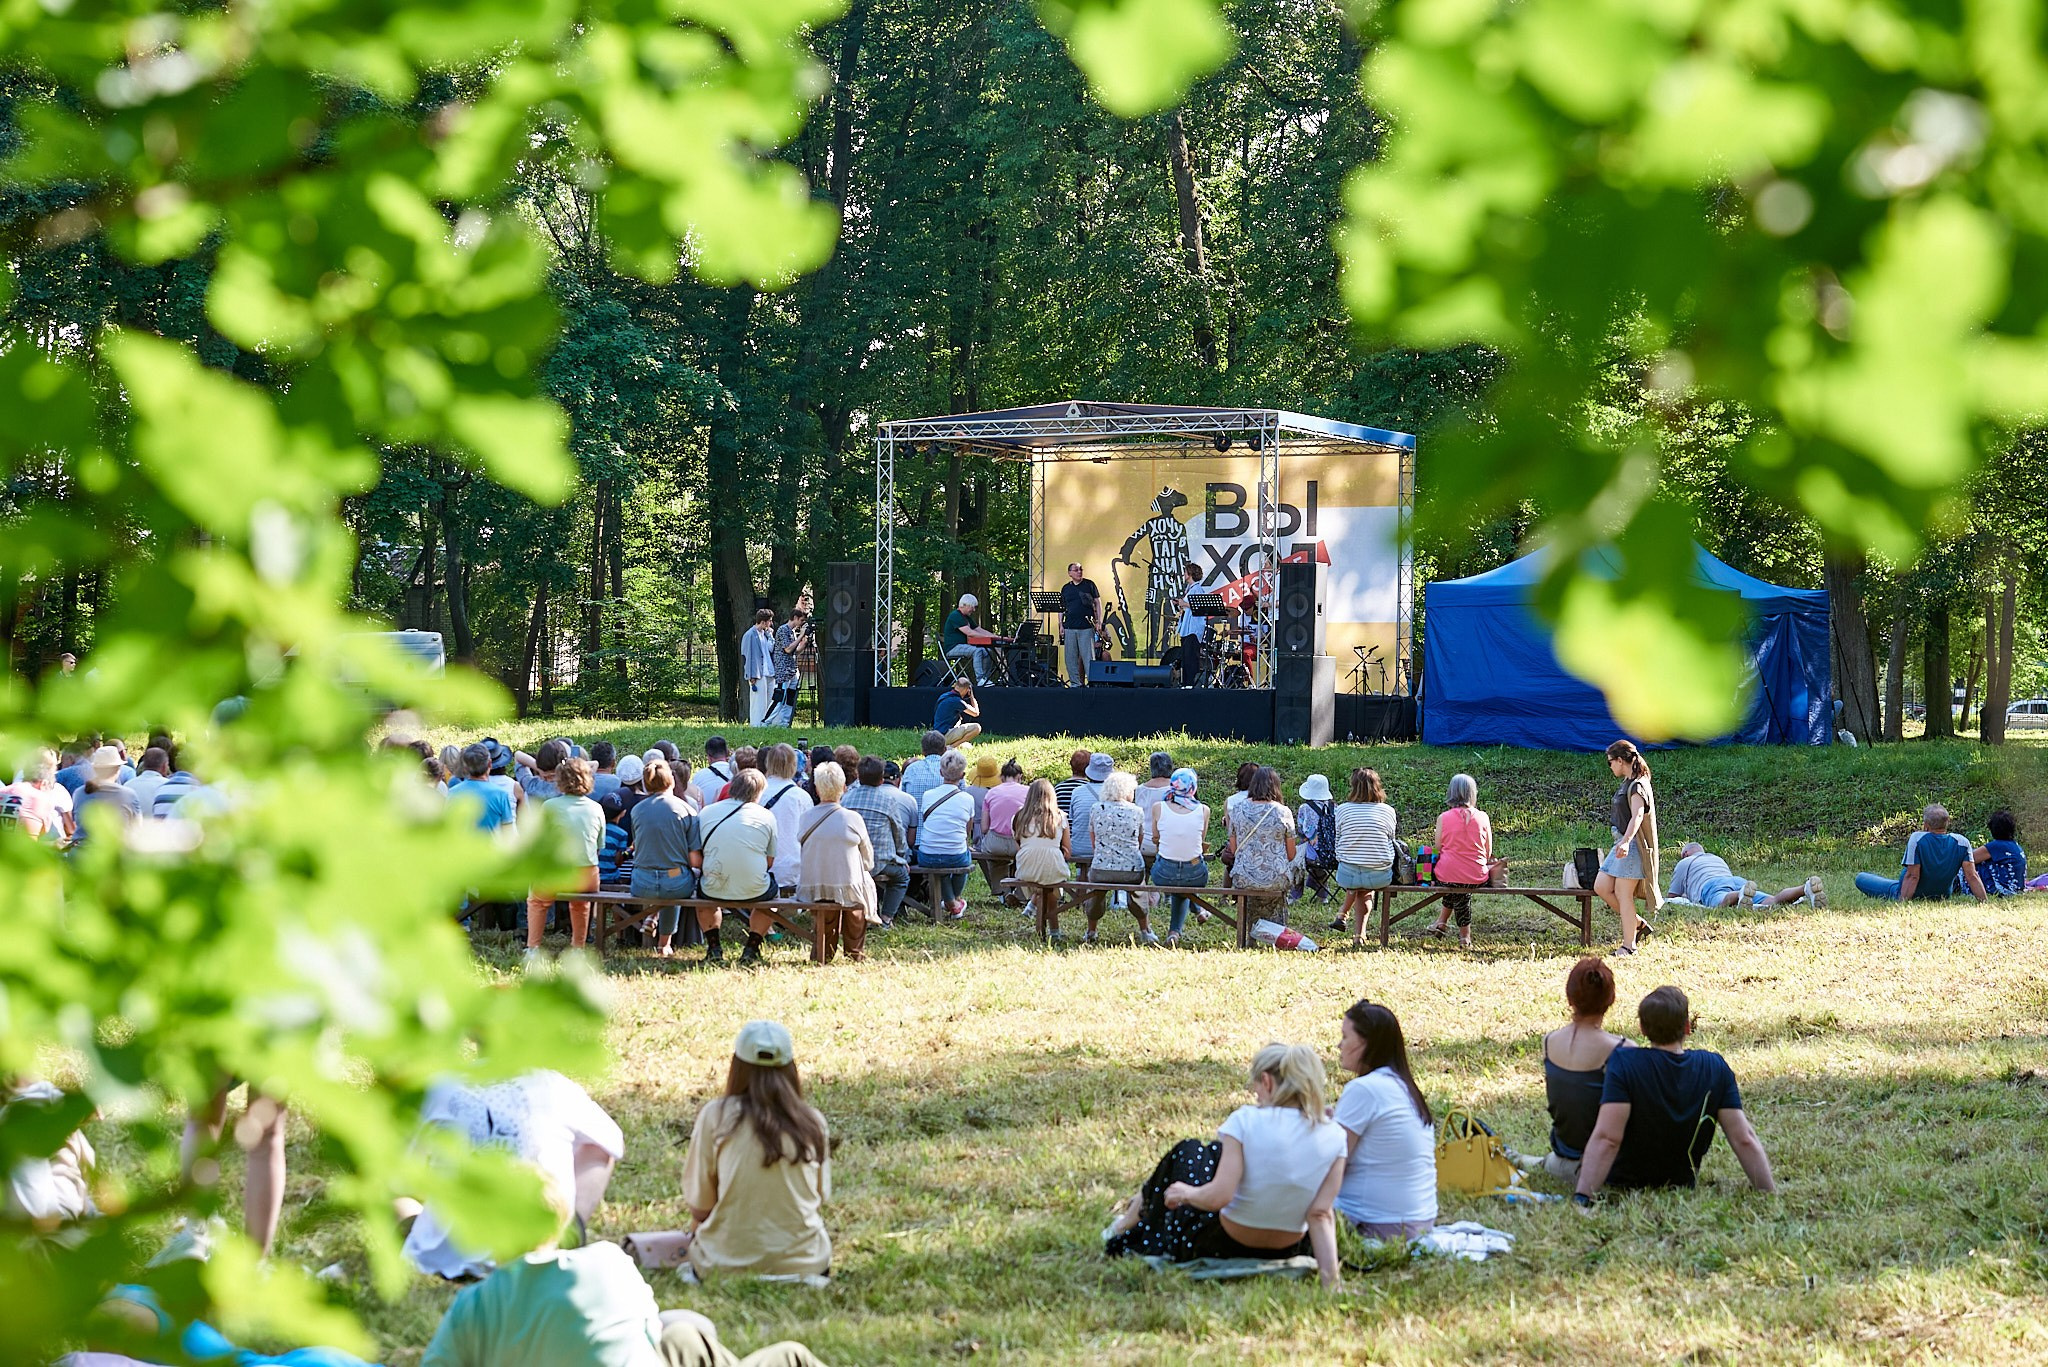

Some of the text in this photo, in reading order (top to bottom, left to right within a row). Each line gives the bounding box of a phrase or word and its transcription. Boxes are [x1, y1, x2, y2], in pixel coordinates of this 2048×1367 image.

[1205, 480, 1318, 538] ВЫ
[1148, 517, 1183, 540] ХОЧУ
[1153, 540, 1177, 558] ГАТ
[1154, 557, 1178, 574] ЧИ
